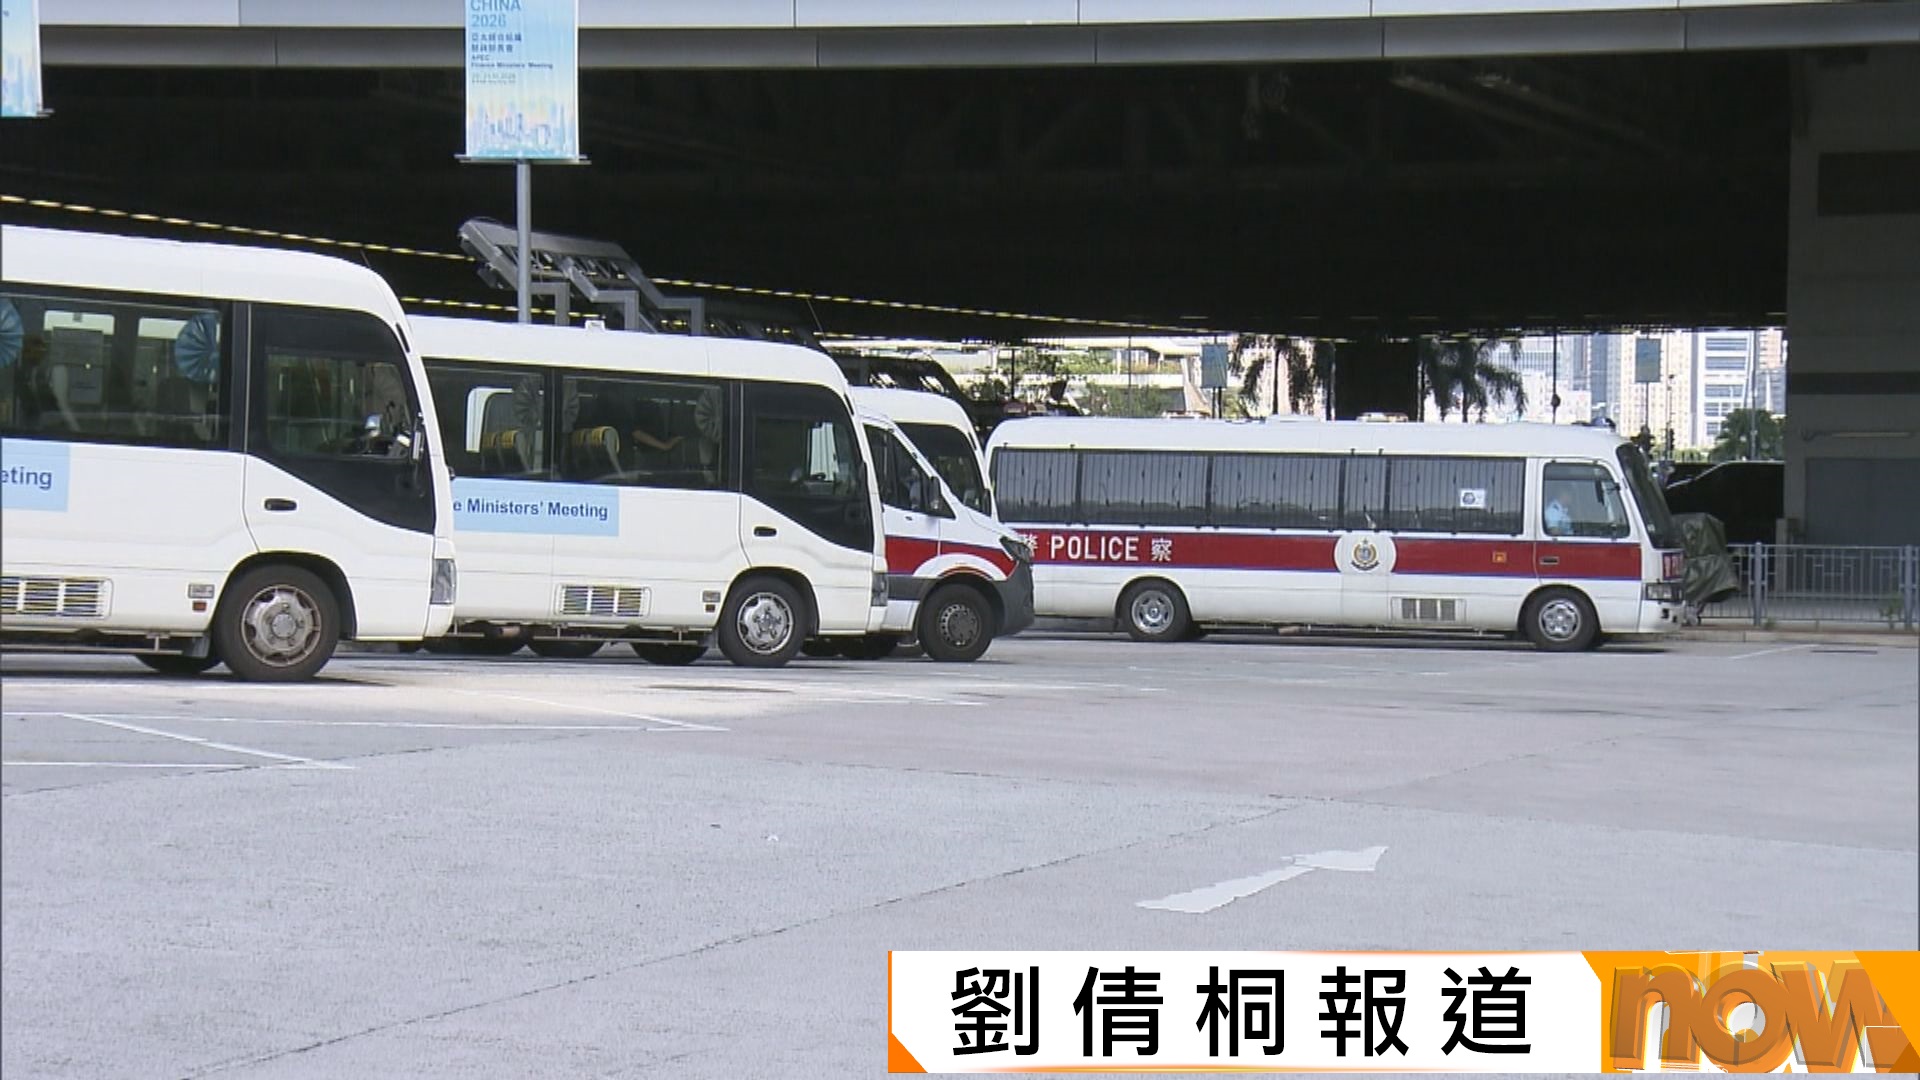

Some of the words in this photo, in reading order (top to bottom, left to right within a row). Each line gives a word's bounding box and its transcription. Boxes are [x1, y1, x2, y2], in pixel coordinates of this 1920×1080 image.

[470, 0, 521, 11] CHINA
[471, 14, 507, 27] 2026
[548, 502, 608, 521] Meeting
[1050, 535, 1139, 561] POLICE
[1151, 538, 1173, 562] 察
